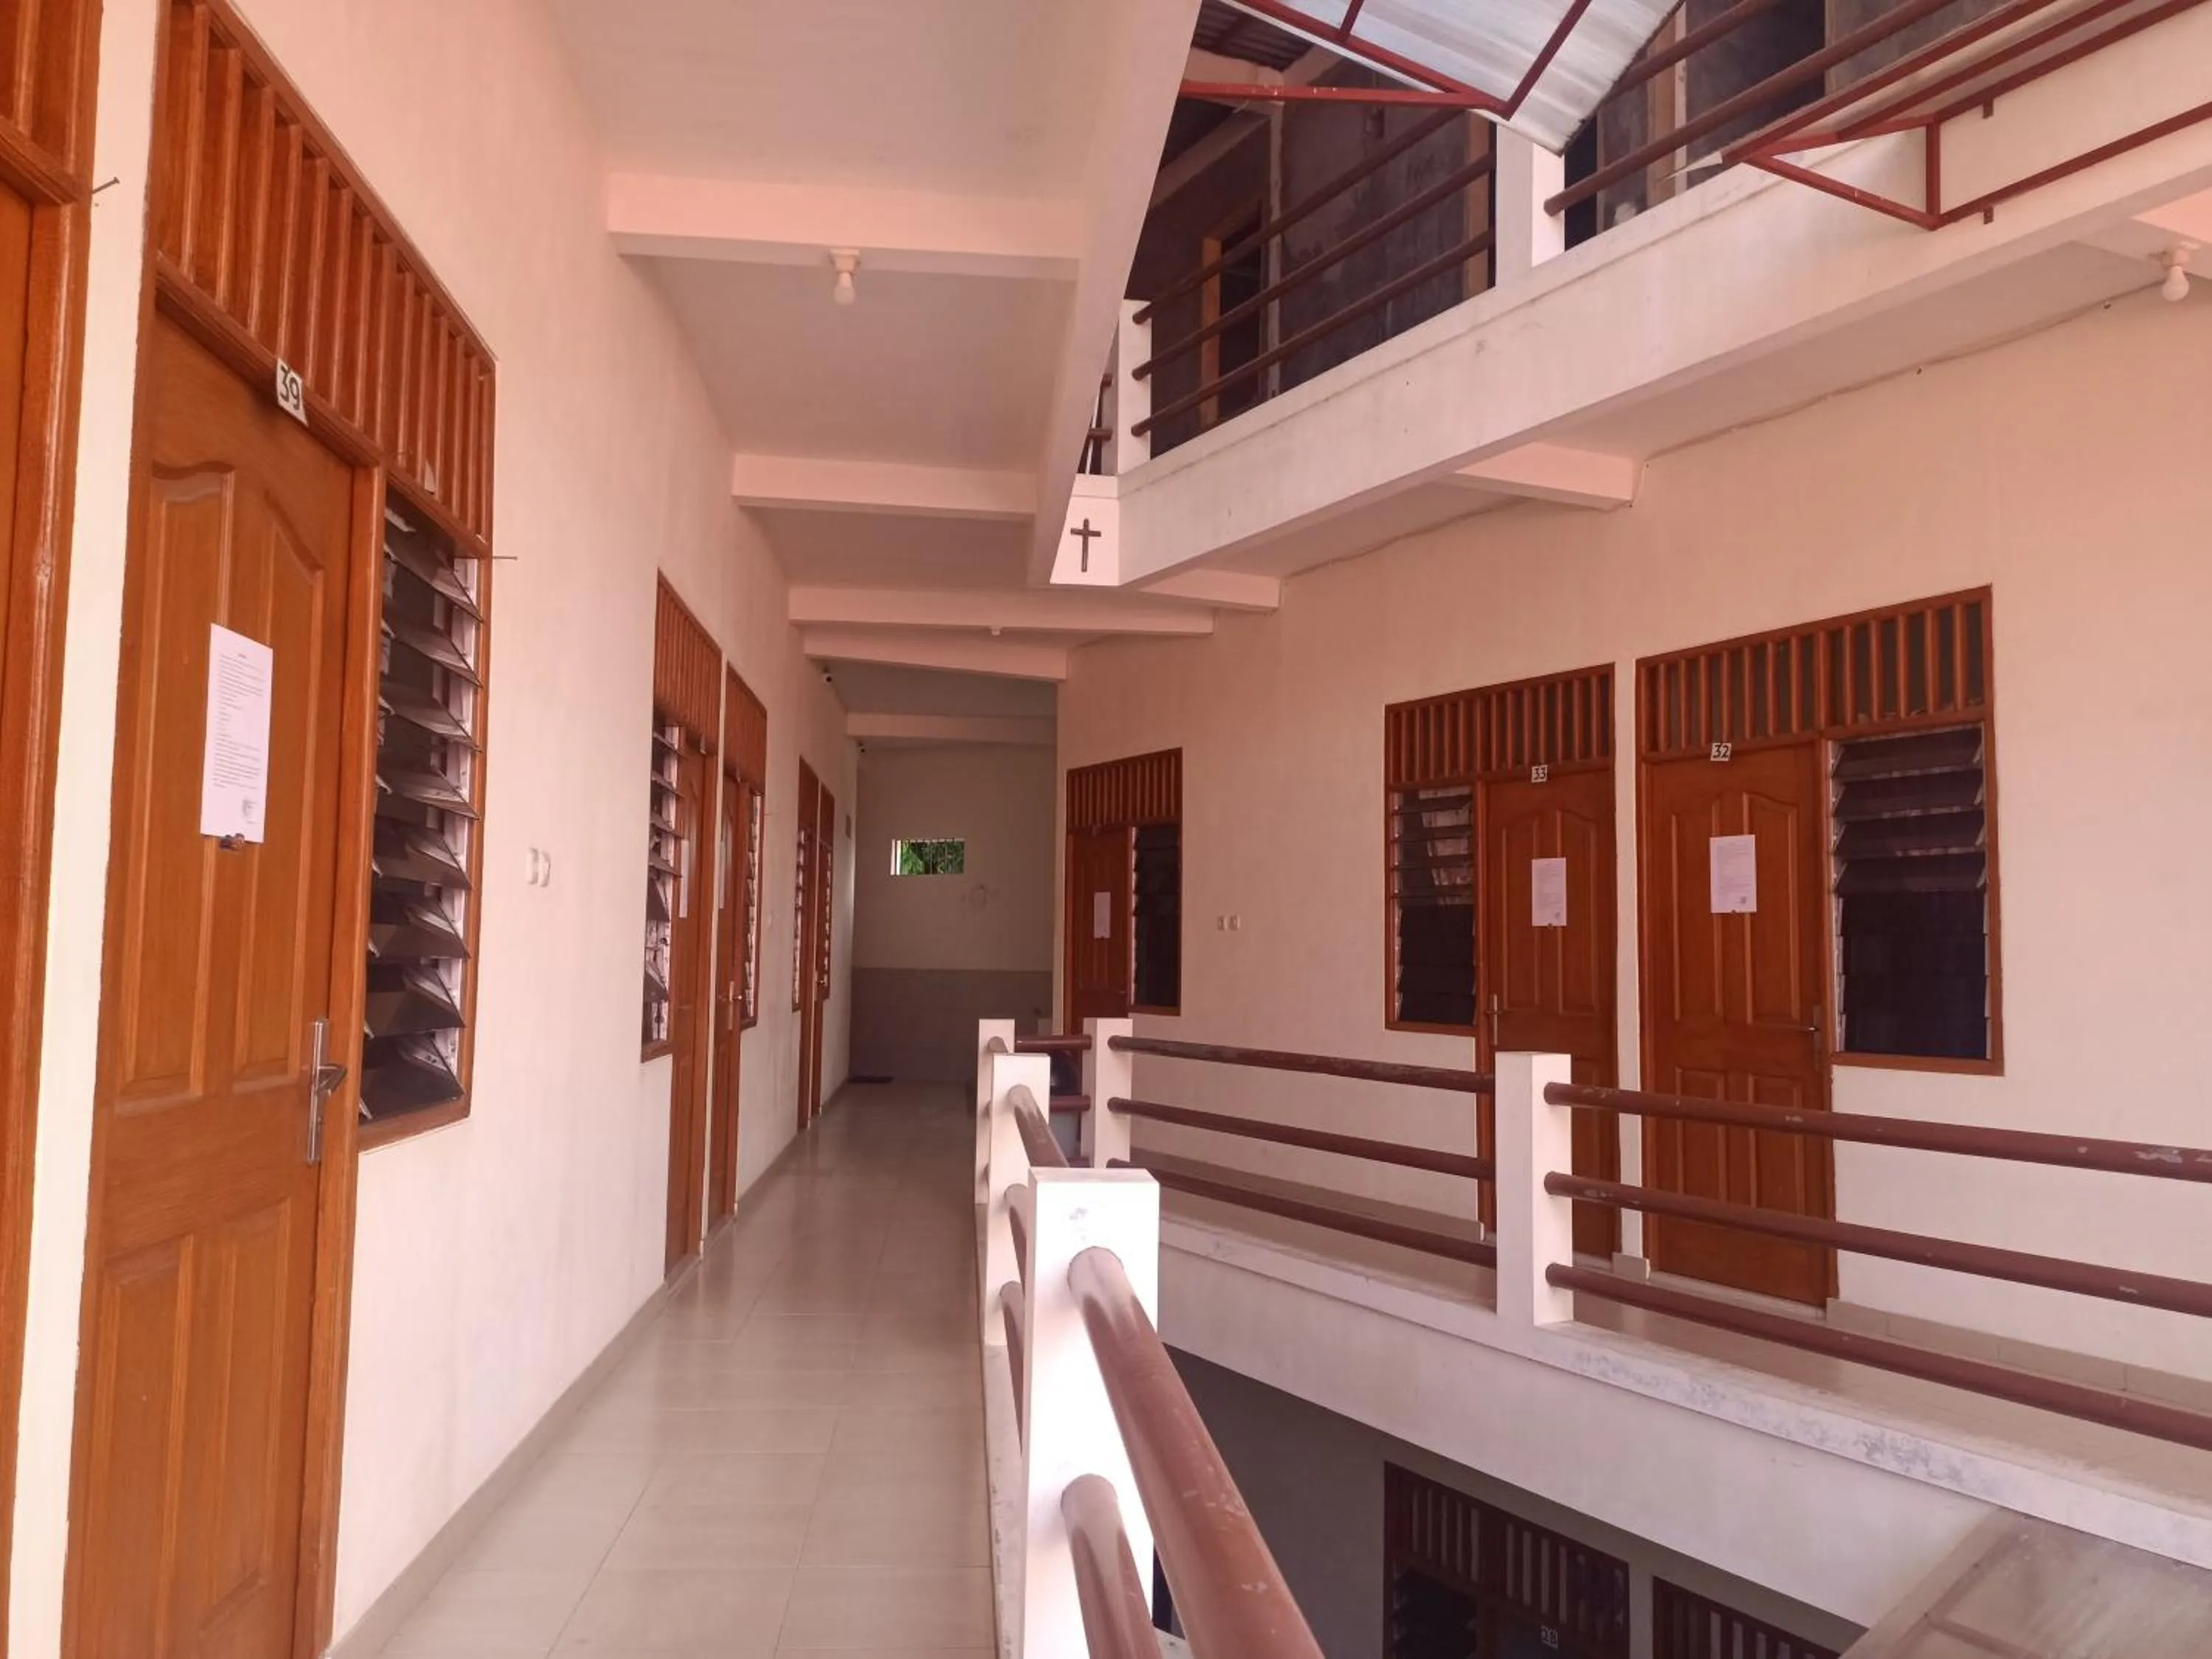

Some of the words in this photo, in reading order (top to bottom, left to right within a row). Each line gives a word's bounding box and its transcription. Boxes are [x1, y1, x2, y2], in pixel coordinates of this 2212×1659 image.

[280, 365, 300, 410] 39
[1712, 743, 1729, 758] 32
[1533, 767, 1546, 780] 33
